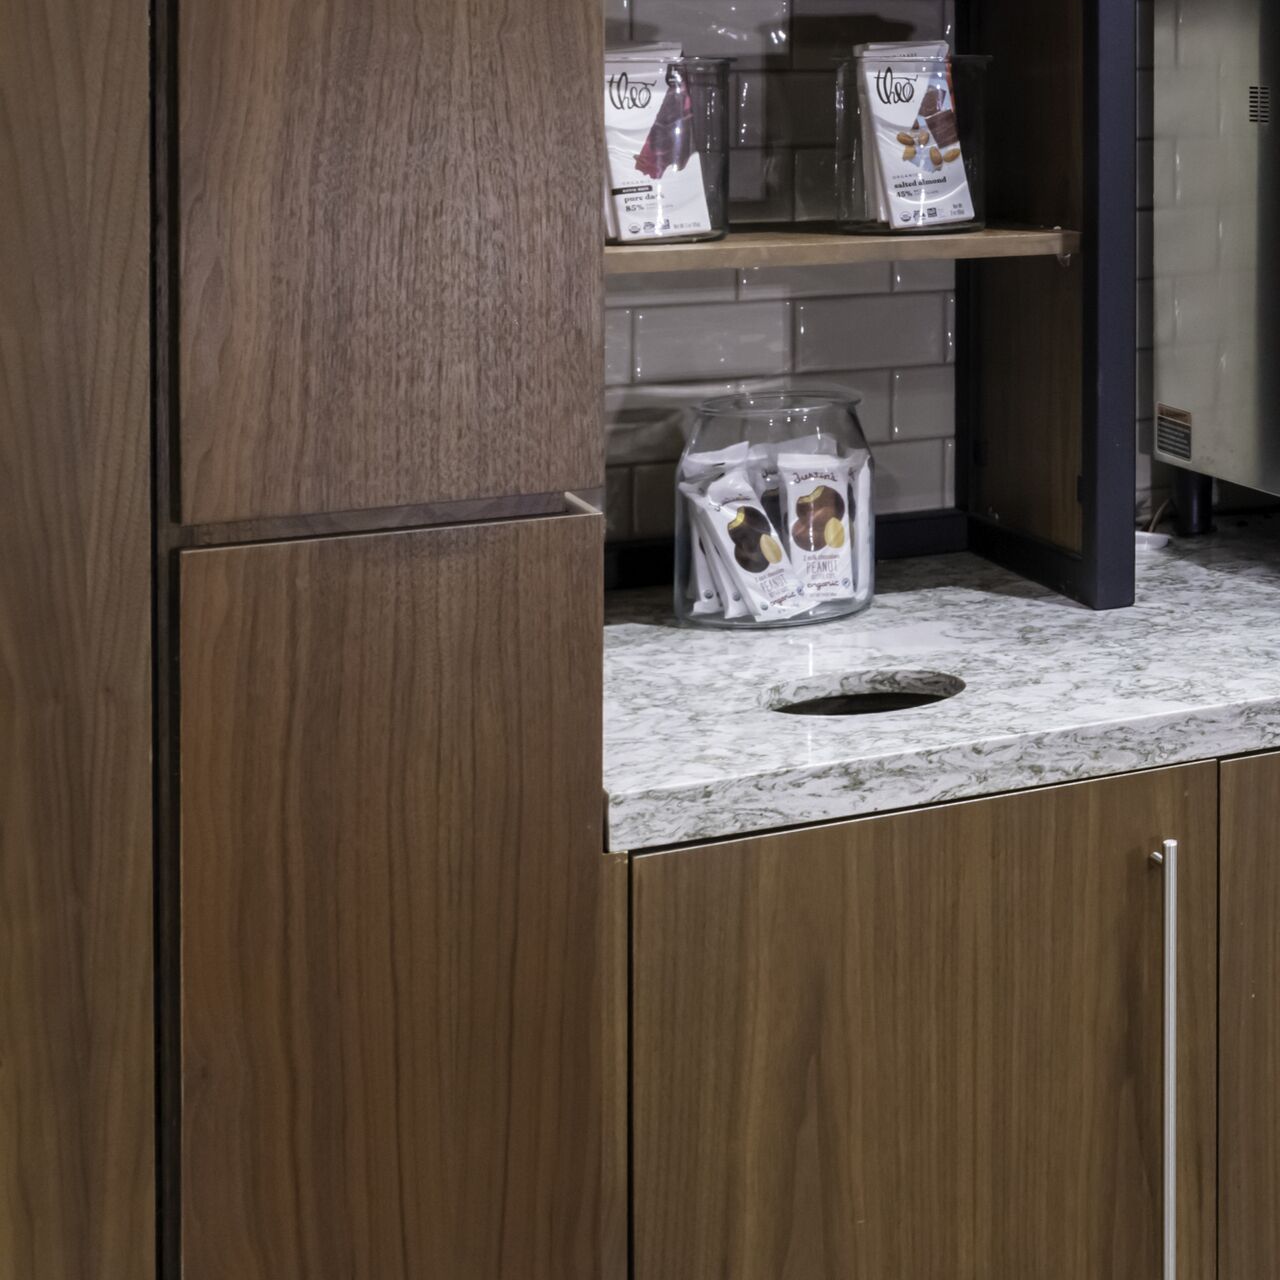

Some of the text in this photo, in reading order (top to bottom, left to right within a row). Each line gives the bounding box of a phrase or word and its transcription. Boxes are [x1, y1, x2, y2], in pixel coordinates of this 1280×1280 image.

[606, 72, 658, 110] theo
[873, 67, 918, 105] theo
[918, 176, 947, 186] almond
[806, 559, 838, 574] PEANUT
